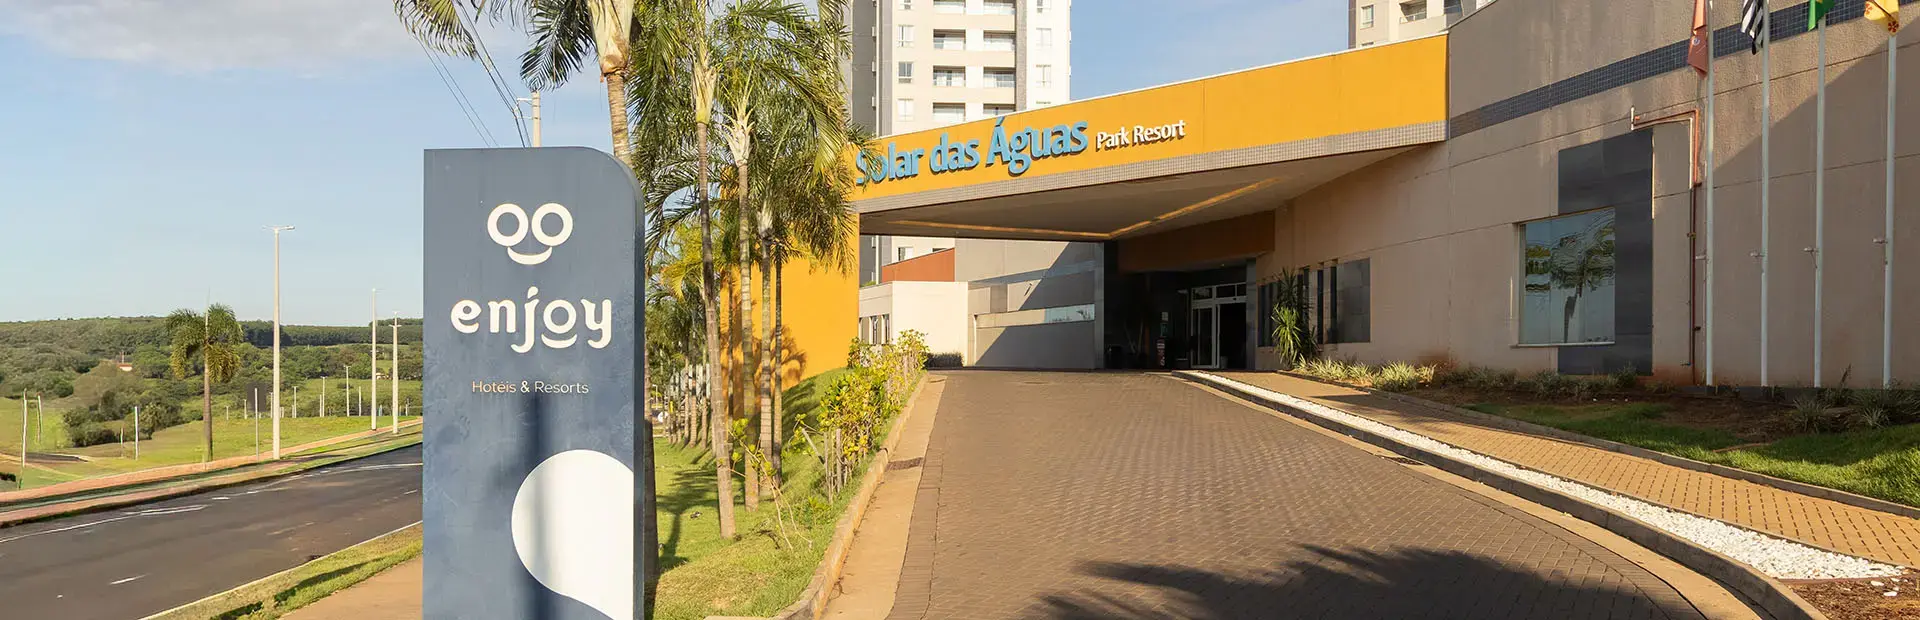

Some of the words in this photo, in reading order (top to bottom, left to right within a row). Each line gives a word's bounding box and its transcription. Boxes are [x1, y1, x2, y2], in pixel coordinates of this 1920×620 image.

[856, 142, 925, 185] Solar
[931, 132, 980, 172] das
[985, 115, 1089, 175] Águas
[1096, 126, 1130, 150] Park
[1133, 119, 1186, 144] Resort
[450, 285, 613, 354] enjoy
[520, 380, 531, 393] &
[534, 380, 589, 394] Resorts
